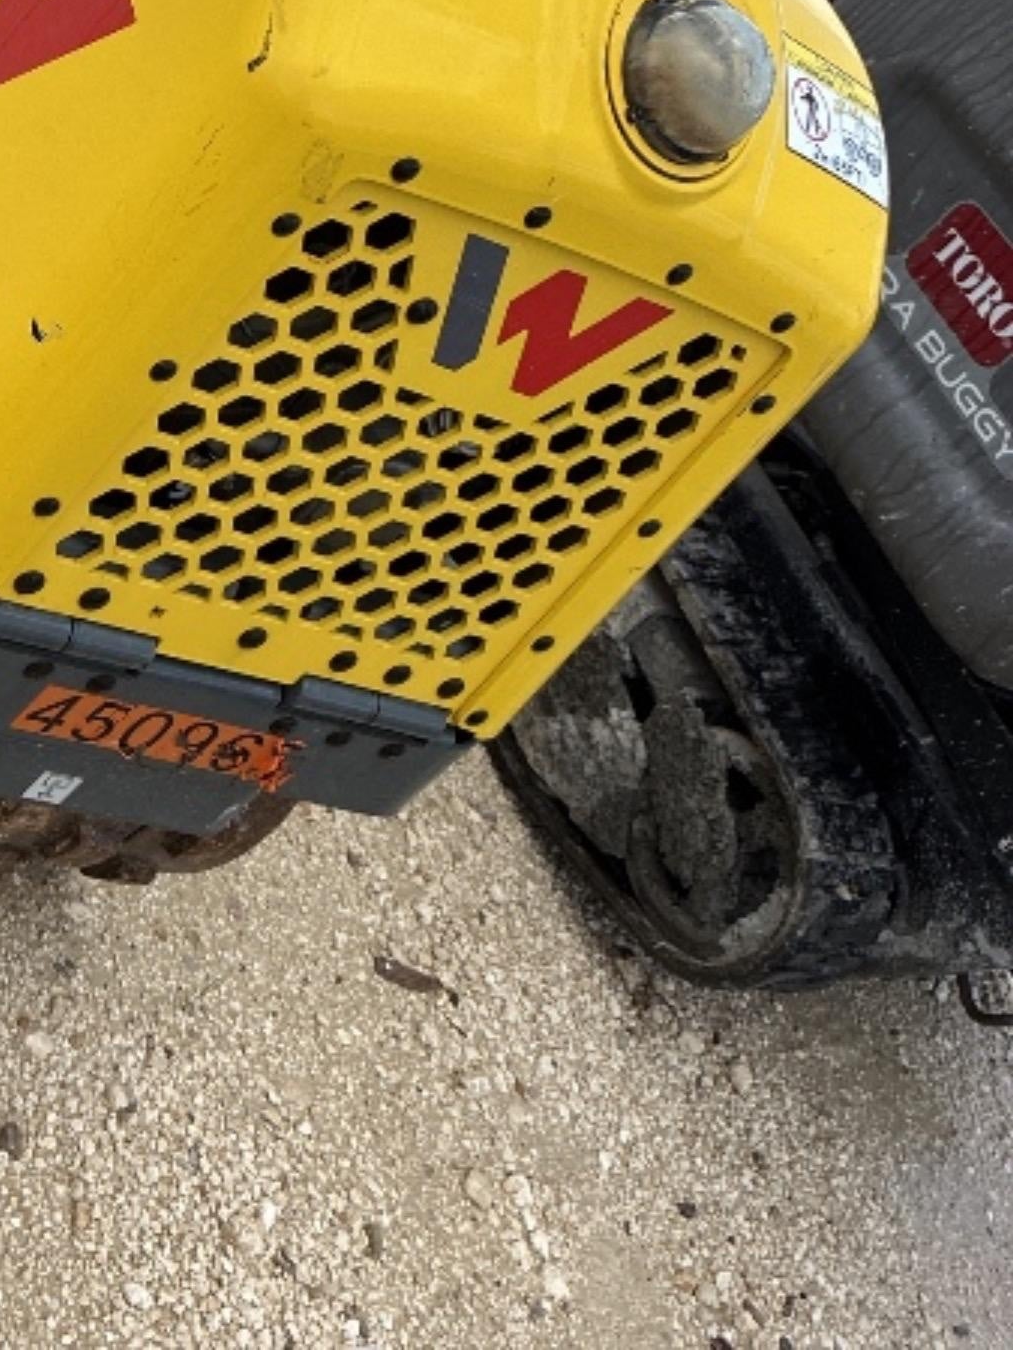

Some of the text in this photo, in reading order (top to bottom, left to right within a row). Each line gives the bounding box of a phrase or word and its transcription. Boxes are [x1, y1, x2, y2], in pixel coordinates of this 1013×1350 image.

[932, 227, 1013, 338] TORO
[915, 329, 1013, 459] BUGGY
[24, 694, 304, 778] 45096
